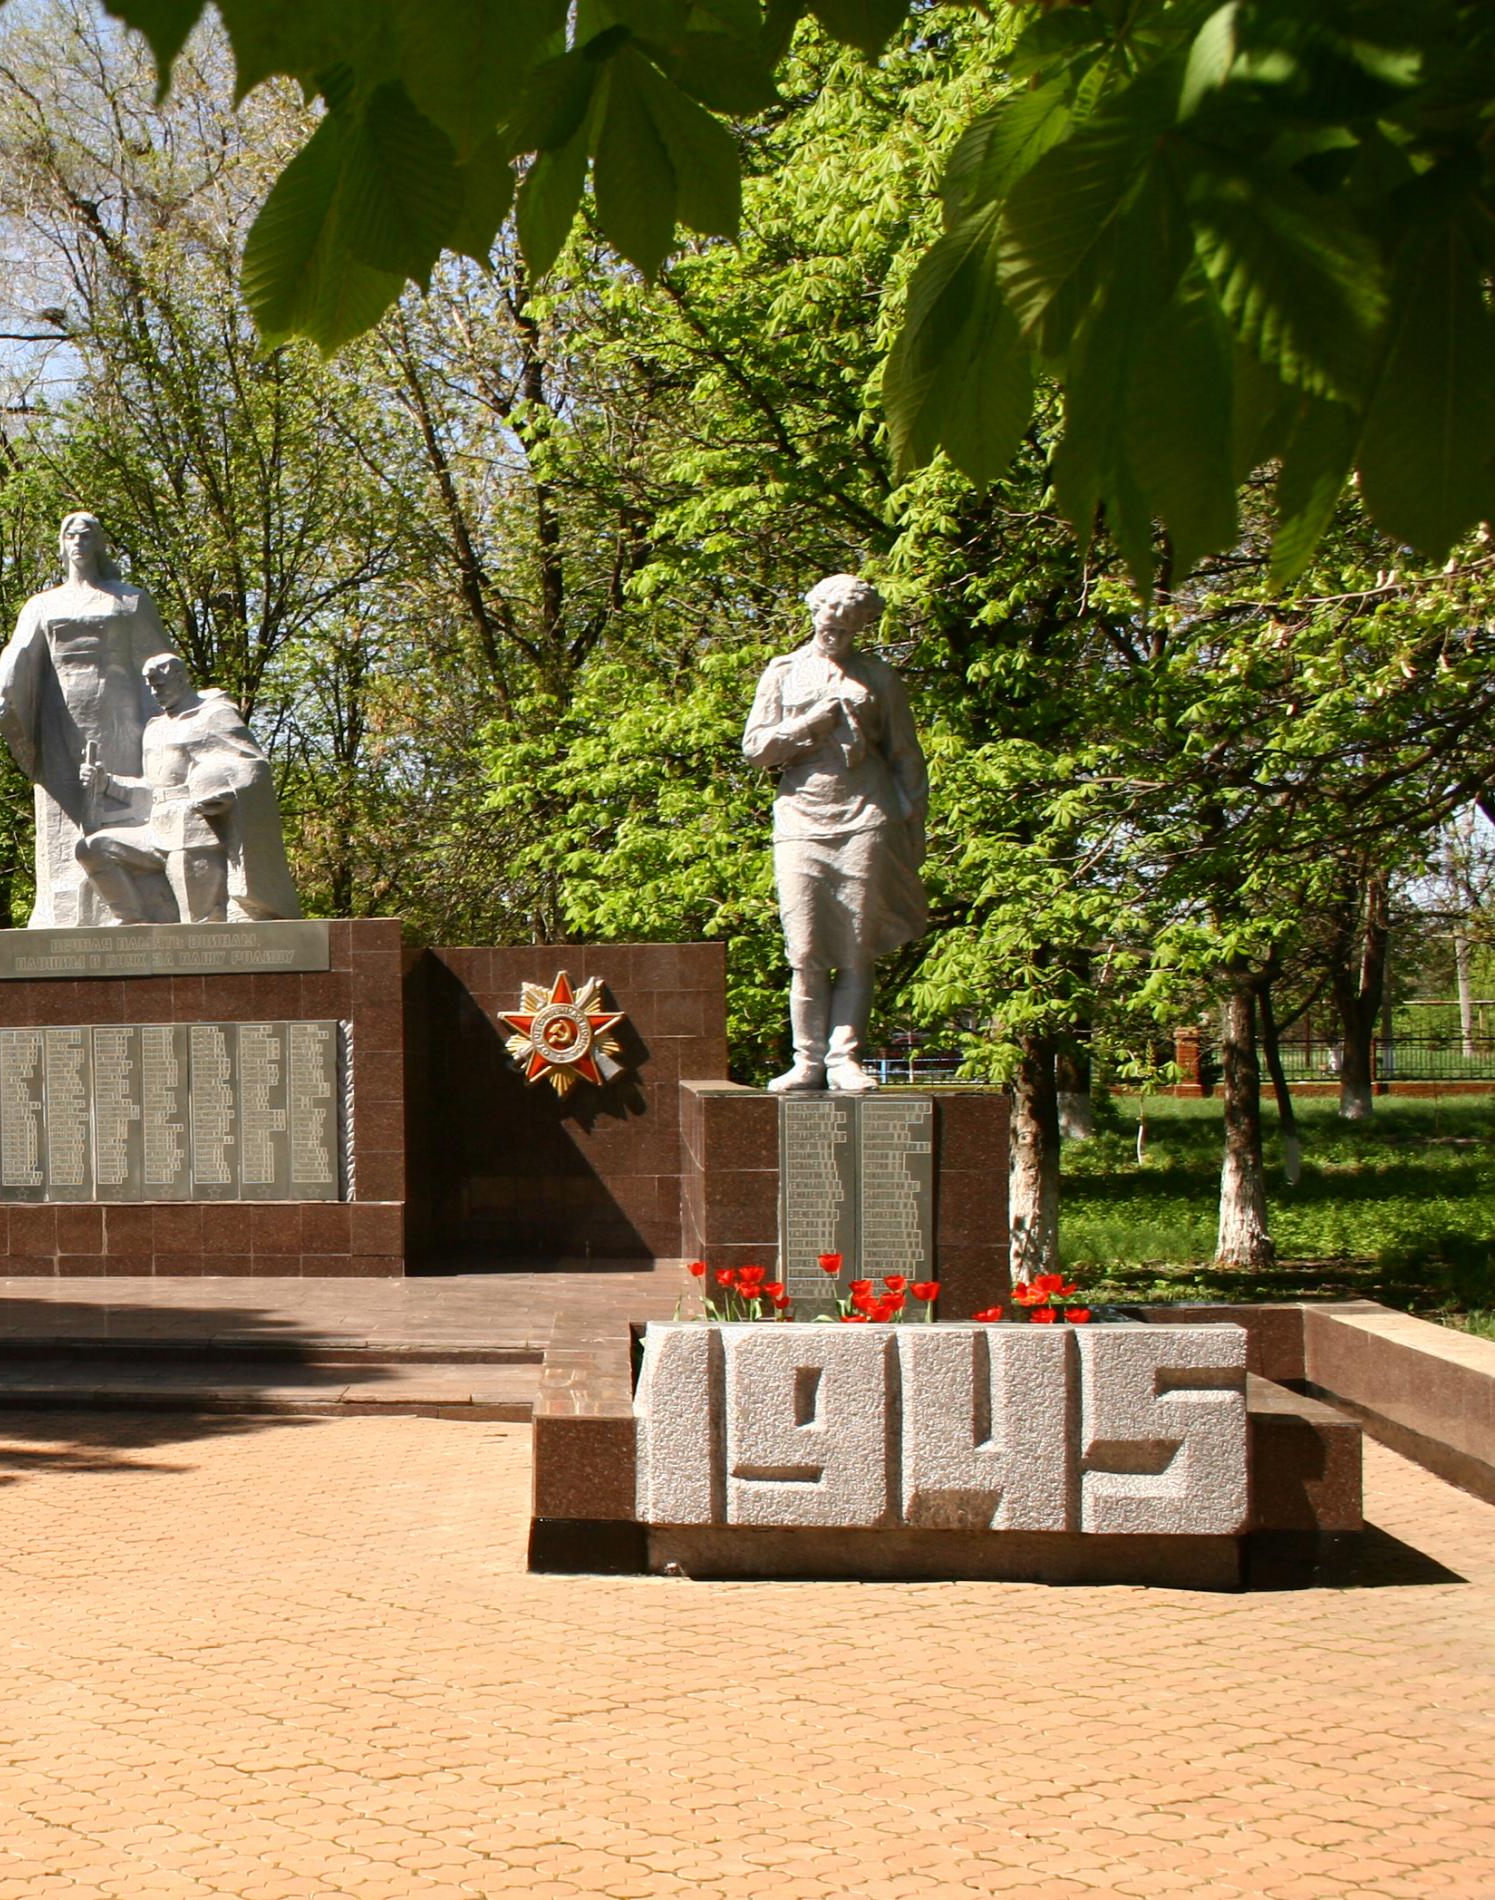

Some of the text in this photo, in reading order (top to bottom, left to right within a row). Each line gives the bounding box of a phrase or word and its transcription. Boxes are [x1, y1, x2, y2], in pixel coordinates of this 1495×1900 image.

[90, 954, 99, 970] В
[151, 952, 173, 968] ЗА
[634, 1321, 1249, 1536] 1945
